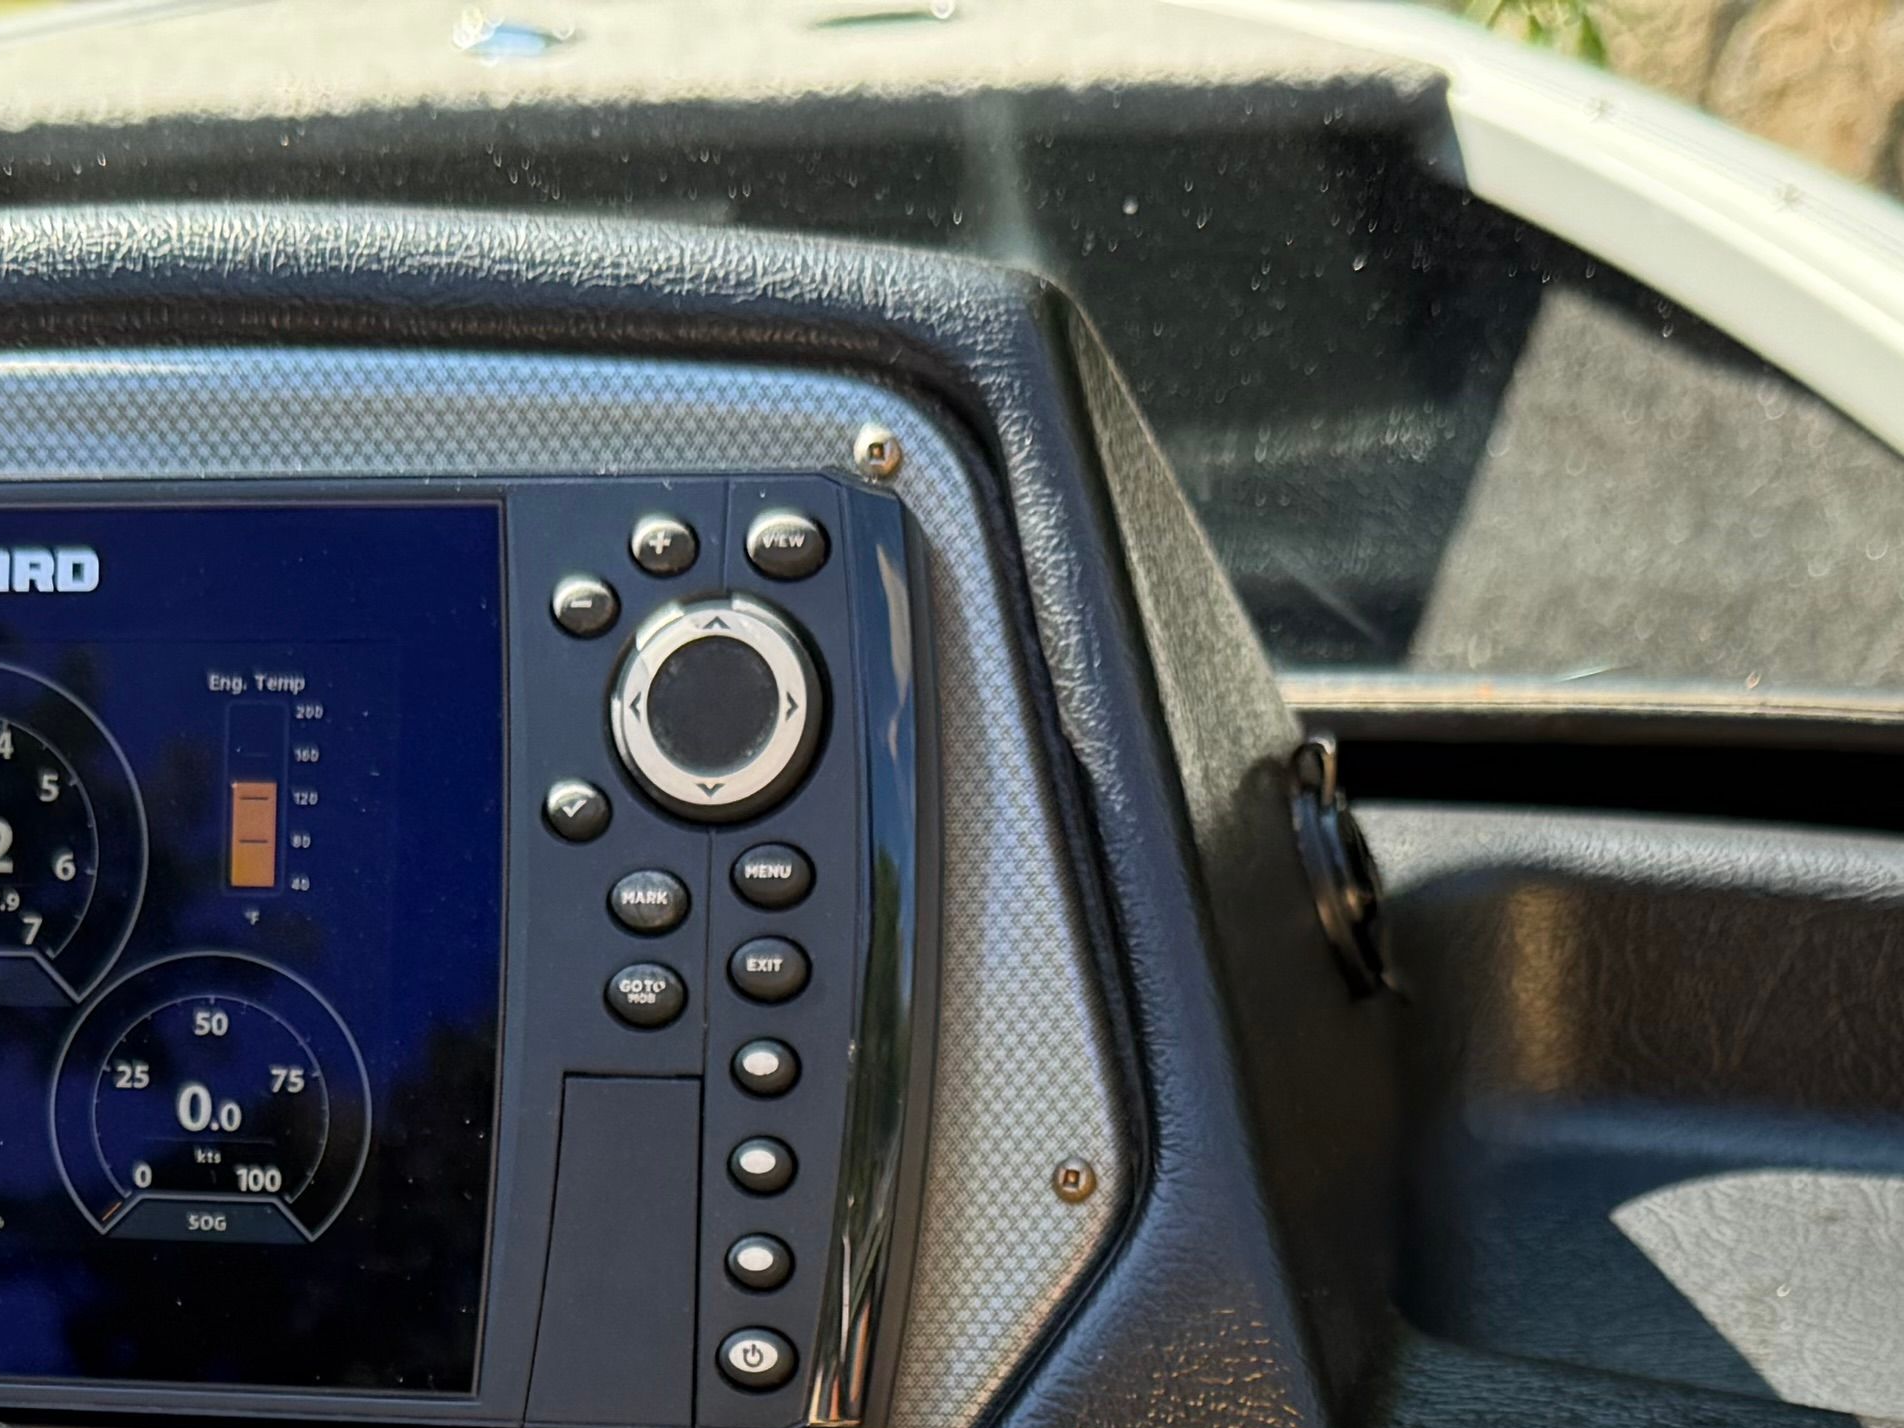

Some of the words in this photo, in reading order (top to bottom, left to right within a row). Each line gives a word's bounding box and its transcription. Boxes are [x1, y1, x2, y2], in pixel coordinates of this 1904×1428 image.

[762, 532, 805, 549] VIEW
[207, 673, 247, 694] Eng.
[254, 673, 305, 694] Temp
[296, 704, 323, 719] 200
[39, 773, 60, 802] 5
[294, 790, 318, 806] 120
[54, 852, 76, 881] 6
[745, 864, 793, 880] MENU
[622, 889, 669, 905] MARK
[22, 916, 43, 945] 7
[745, 956, 783, 973] EXIT
[193, 1009, 229, 1036] 50
[115, 1063, 150, 1089] 25
[270, 1068, 305, 1094] 75
[178, 1083, 242, 1132] 0.0
[195, 1149, 222, 1164] kts
[134, 1163, 153, 1188] 0
[236, 1167, 282, 1192] 100
[188, 1212, 227, 1231] SOG
